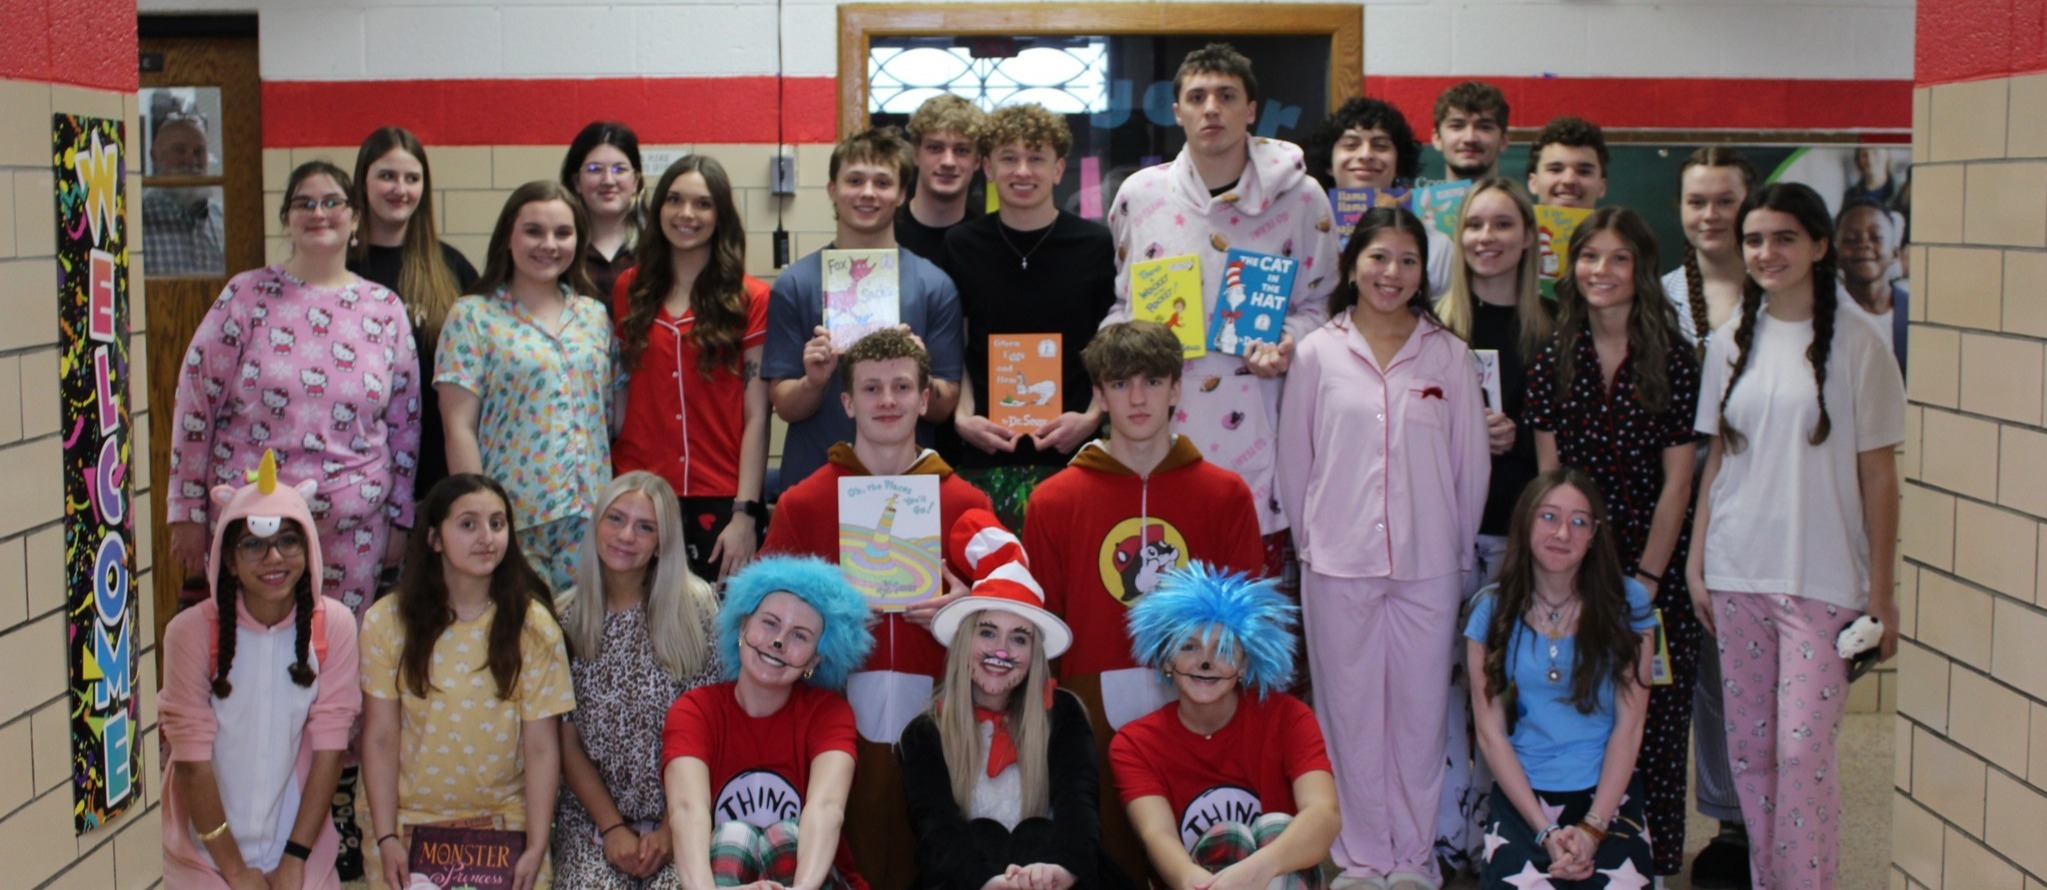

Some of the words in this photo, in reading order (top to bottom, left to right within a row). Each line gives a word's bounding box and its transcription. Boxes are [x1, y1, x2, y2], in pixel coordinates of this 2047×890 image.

[1338, 191, 1367, 200] llama
[1338, 202, 1367, 211] llama
[828, 259, 848, 275] Fox
[1240, 255, 1259, 267] THE
[1260, 256, 1293, 274] CAT
[1267, 274, 1280, 283] IN
[1261, 283, 1280, 294] THE
[1250, 292, 1287, 310] HAT
[1003, 350, 1025, 362] Eggs
[997, 376, 1017, 384] Ham
[1008, 415, 1022, 427] Dr.
[76, 130, 131, 807] WELCOME
[867, 483, 882, 491] the
[884, 480, 912, 495] Places
[913, 501, 935, 515] Go!
[718, 786, 797, 821] THING
[420, 841, 510, 868] MONSTER
[429, 861, 503, 887] Princess
